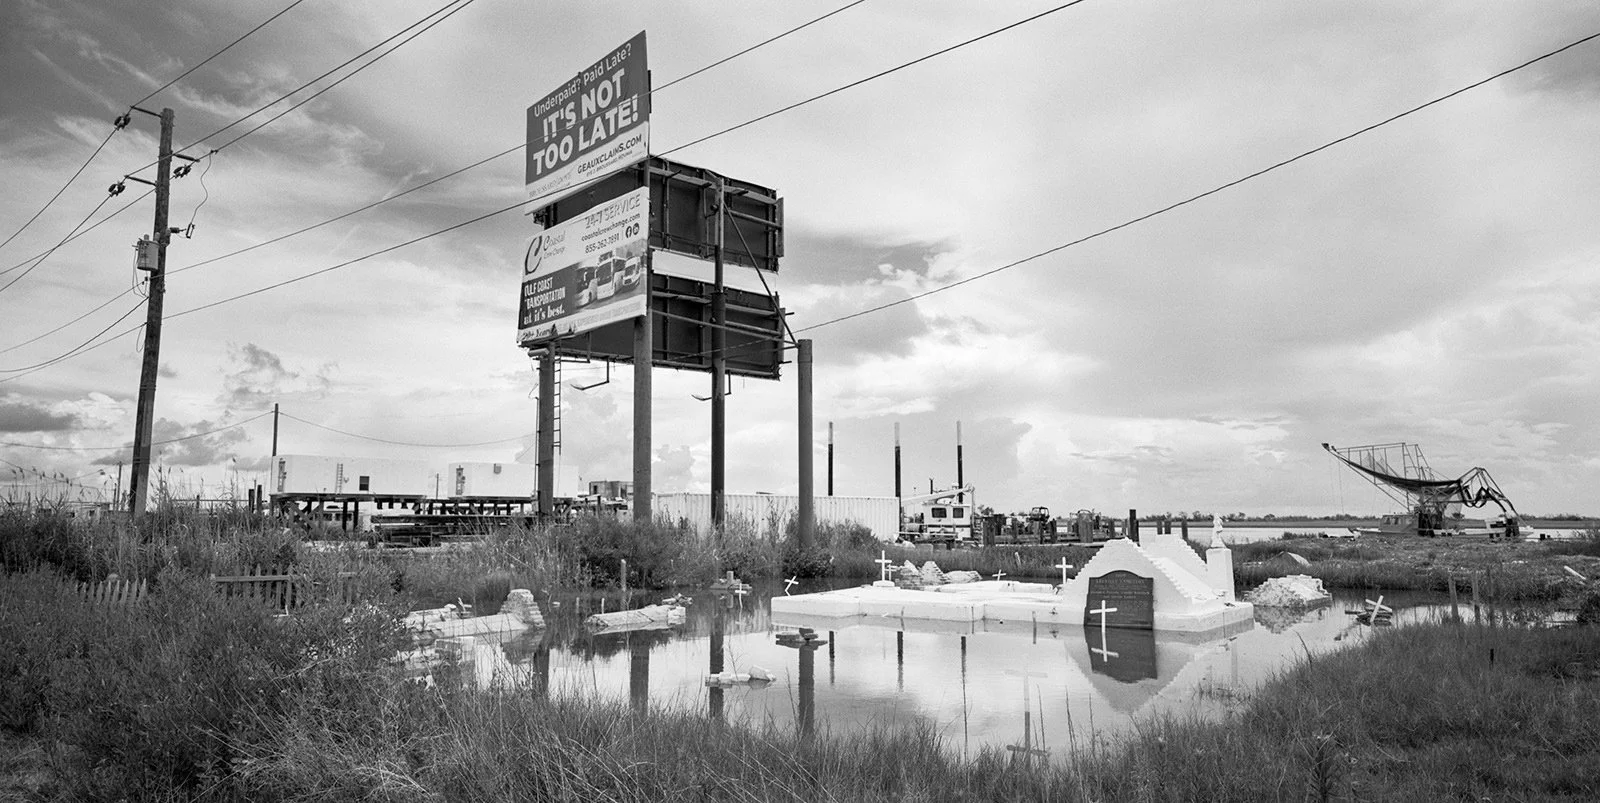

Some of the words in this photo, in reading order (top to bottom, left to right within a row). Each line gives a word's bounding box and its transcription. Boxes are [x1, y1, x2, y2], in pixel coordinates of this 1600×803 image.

[534, 78, 582, 117] Underpaid?
[583, 61, 604, 86] Paid
[606, 43, 631, 70] Late?
[543, 101, 577, 143] IT'S
[581, 68, 625, 120] NOT
[533, 135, 573, 175] TOO
[578, 93, 638, 152] LATE!
[604, 193, 641, 222] SERVICE
[537, 276, 553, 293] COAST
